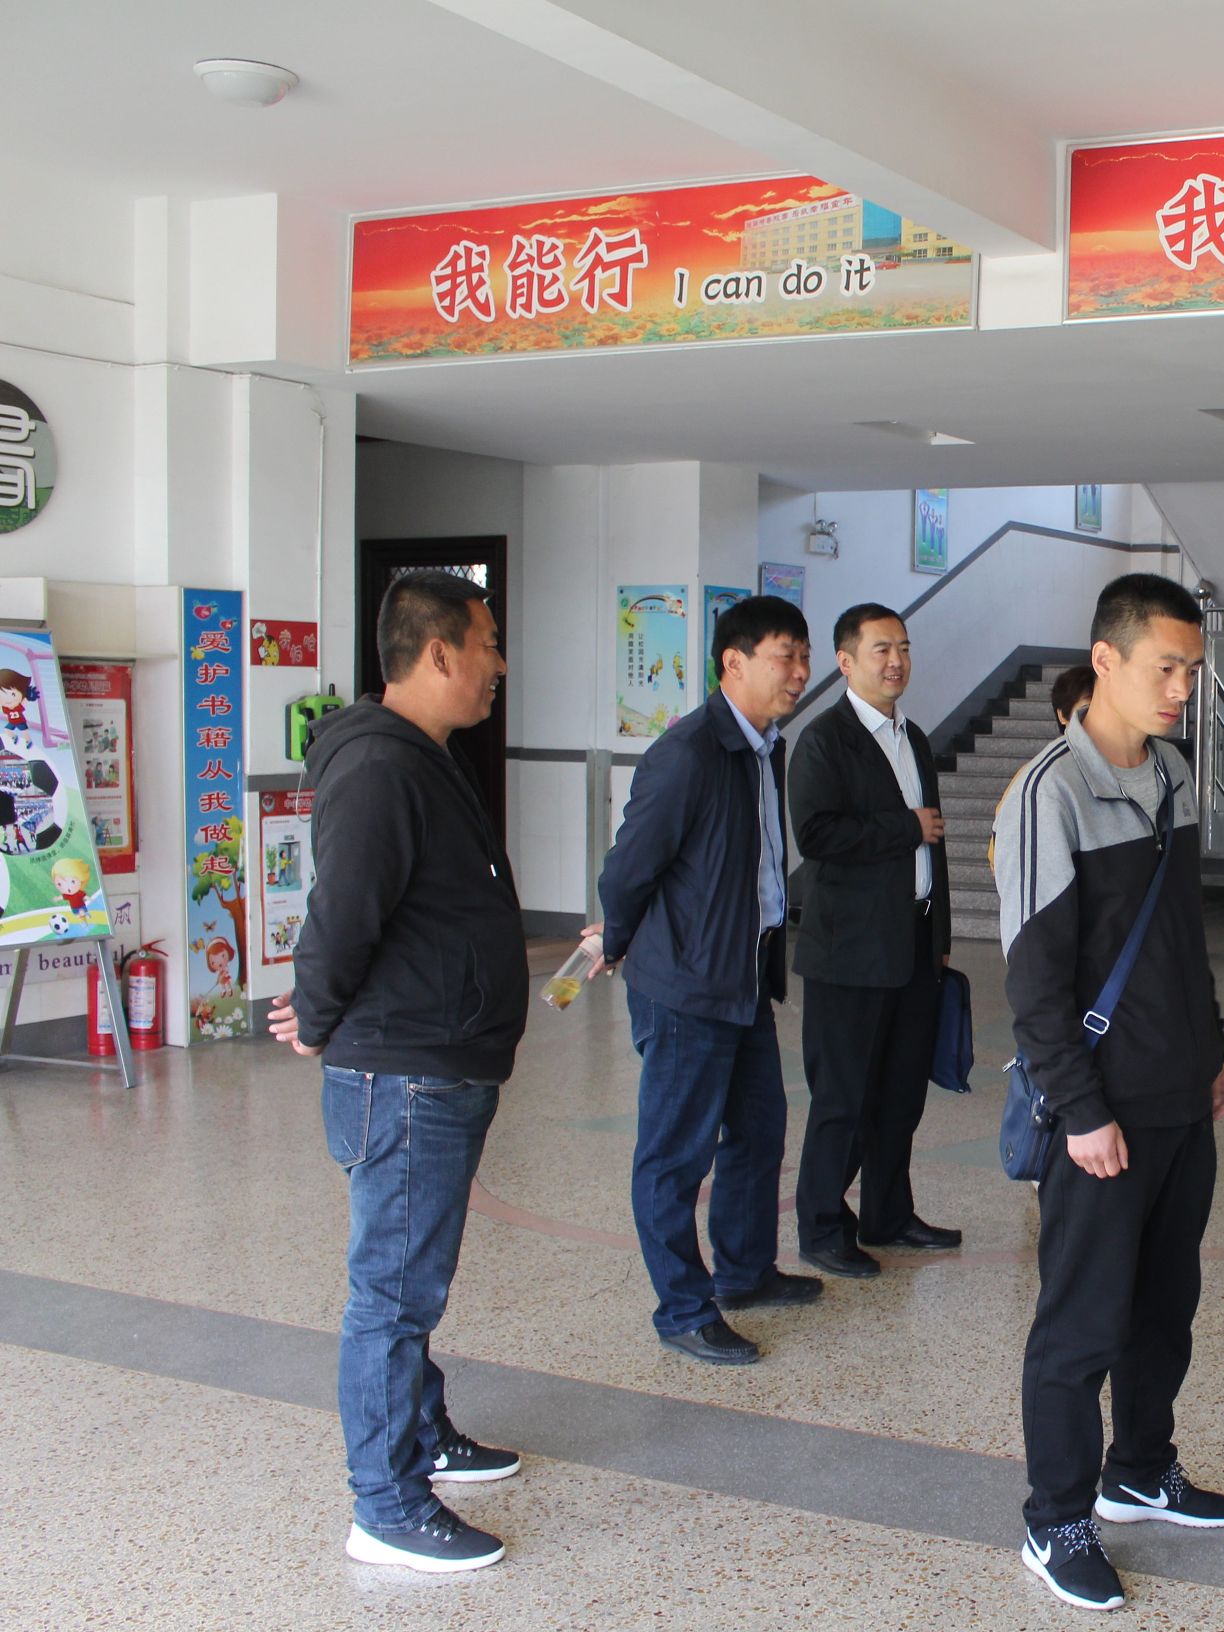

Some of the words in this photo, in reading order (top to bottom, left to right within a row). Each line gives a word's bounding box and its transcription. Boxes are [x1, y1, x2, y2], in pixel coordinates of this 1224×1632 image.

[432, 229, 648, 322] 我能行
[704, 276, 763, 300] can
[783, 263, 823, 294] do
[842, 258, 872, 292] it
[196, 630, 233, 875] 爱护书籍从我做起
